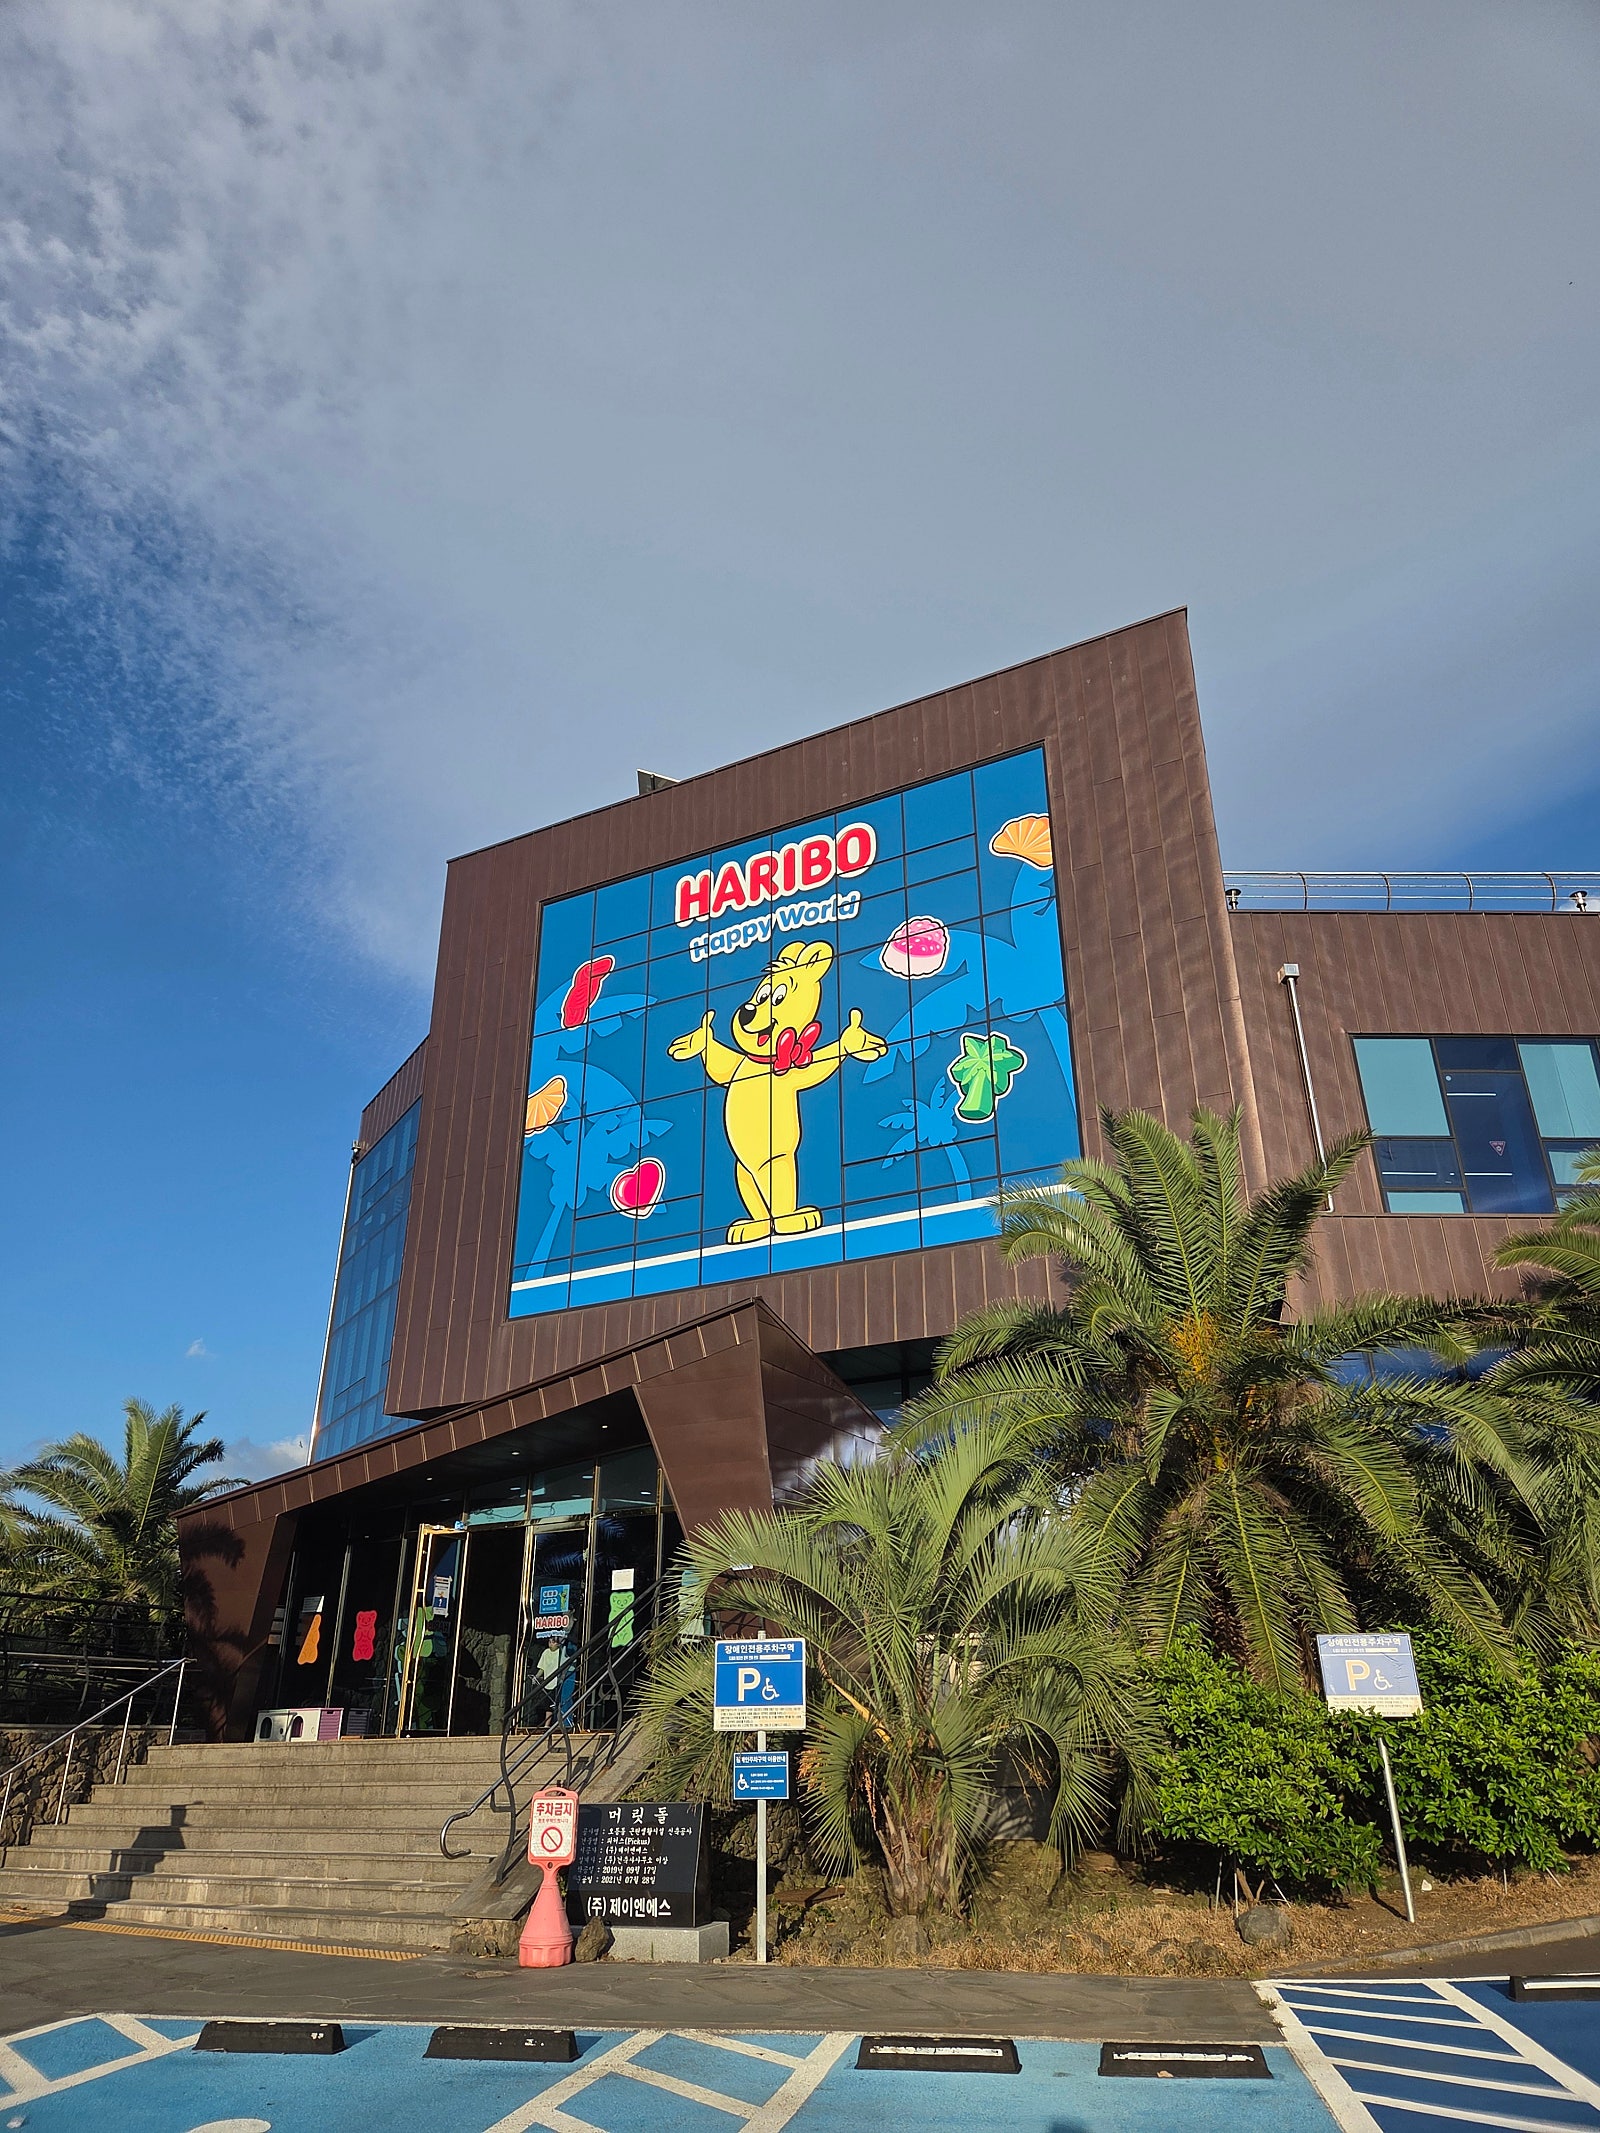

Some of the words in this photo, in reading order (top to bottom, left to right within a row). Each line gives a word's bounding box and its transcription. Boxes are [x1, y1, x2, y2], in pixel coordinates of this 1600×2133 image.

[677, 825, 874, 924] HARIBO
[691, 915, 772, 960] Happy
[775, 892, 860, 931] World
[535, 1615, 569, 1629] HARIBO
[724, 1643, 795, 1655] 장애인전용주차구역
[1327, 1637, 1401, 1647] 장애인전용주차구역
[1345, 1660, 1371, 1691] P
[737, 1667, 761, 1702] P
[536, 1802, 572, 1816] 주차금지
[602, 1865, 623, 1875] 2019년
[643, 1865, 657, 1875] 17일
[600, 1875, 622, 1885] 2021년
[641, 1875, 656, 1885] 28일
